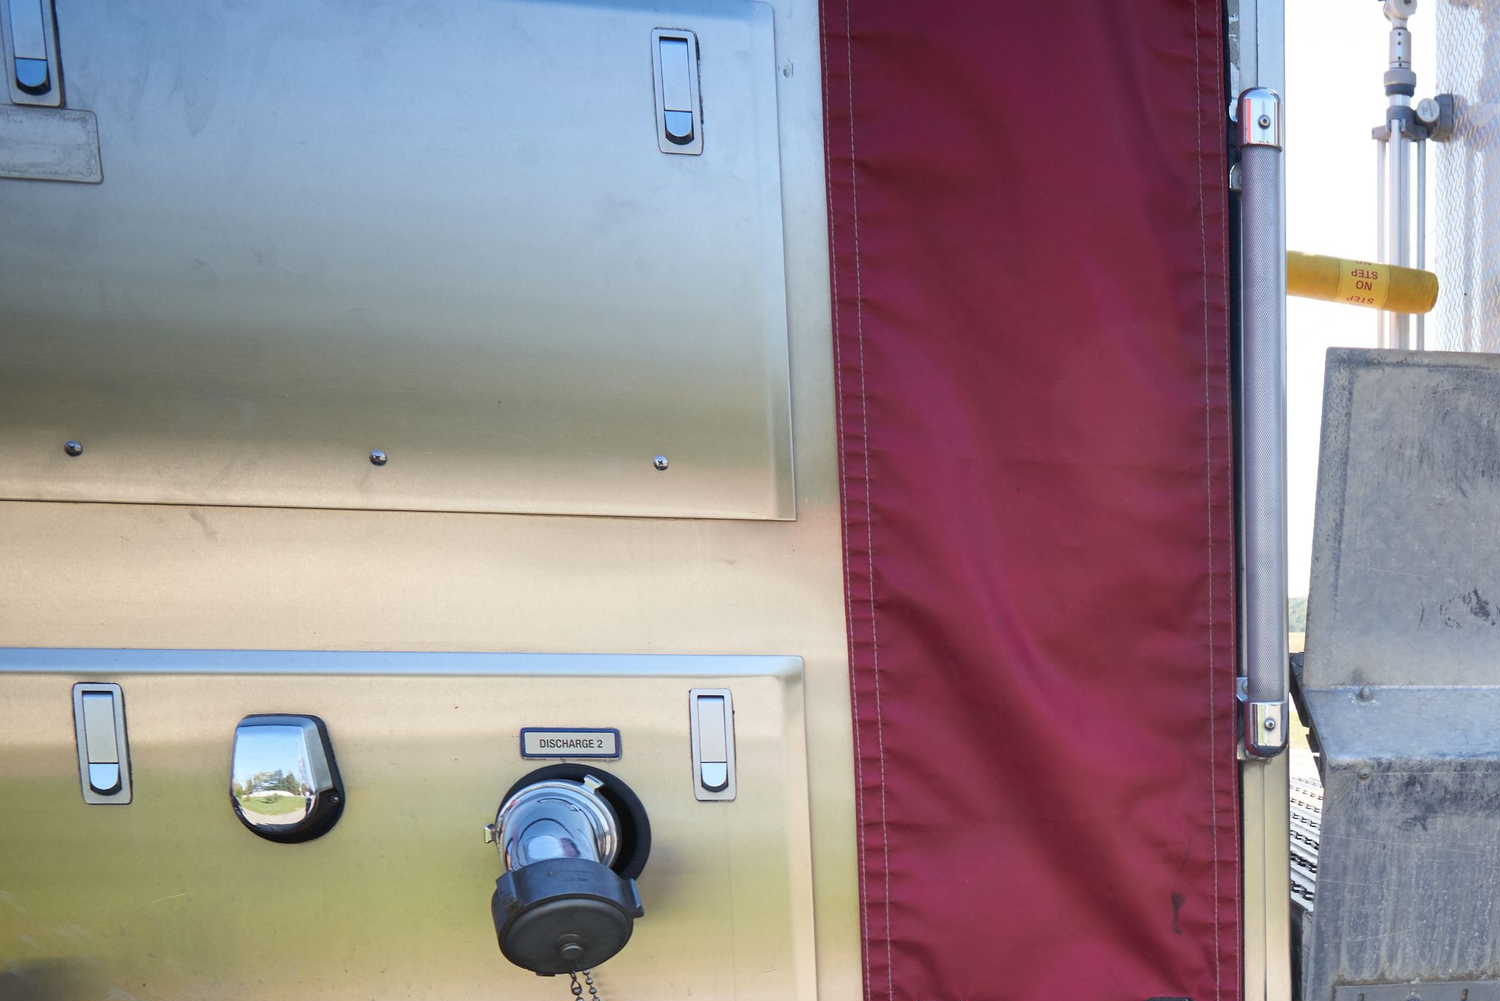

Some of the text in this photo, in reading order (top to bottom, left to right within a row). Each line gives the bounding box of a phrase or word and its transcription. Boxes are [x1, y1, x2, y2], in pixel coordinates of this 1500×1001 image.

[1350, 268, 1379, 280] STEP
[1355, 280, 1373, 291] NO
[1346, 295, 1375, 305] STEP
[539, 739, 603, 749] DISCHARGE 2
